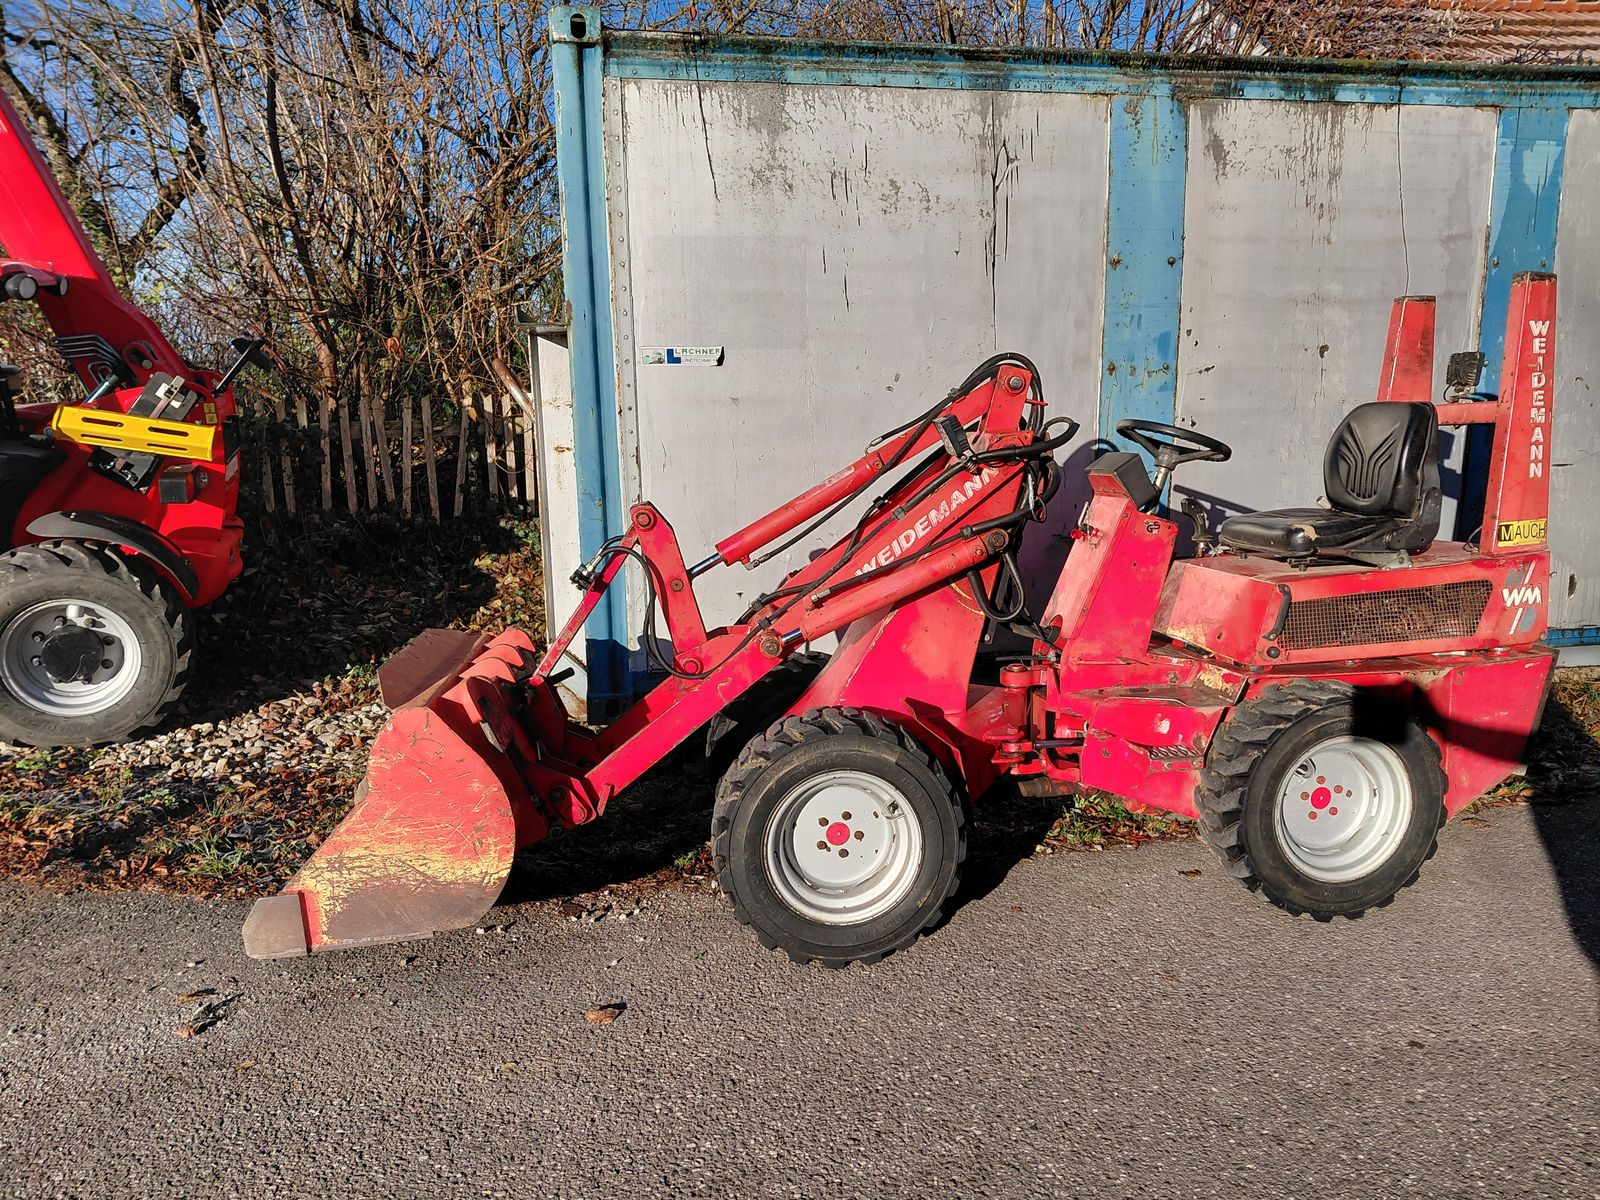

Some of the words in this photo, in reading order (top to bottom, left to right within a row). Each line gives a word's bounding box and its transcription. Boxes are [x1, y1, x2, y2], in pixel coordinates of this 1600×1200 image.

[1528, 320, 1550, 479] WEIDEMANN
[1499, 523, 1546, 541] MAUCH
[1501, 586, 1542, 608] WM
